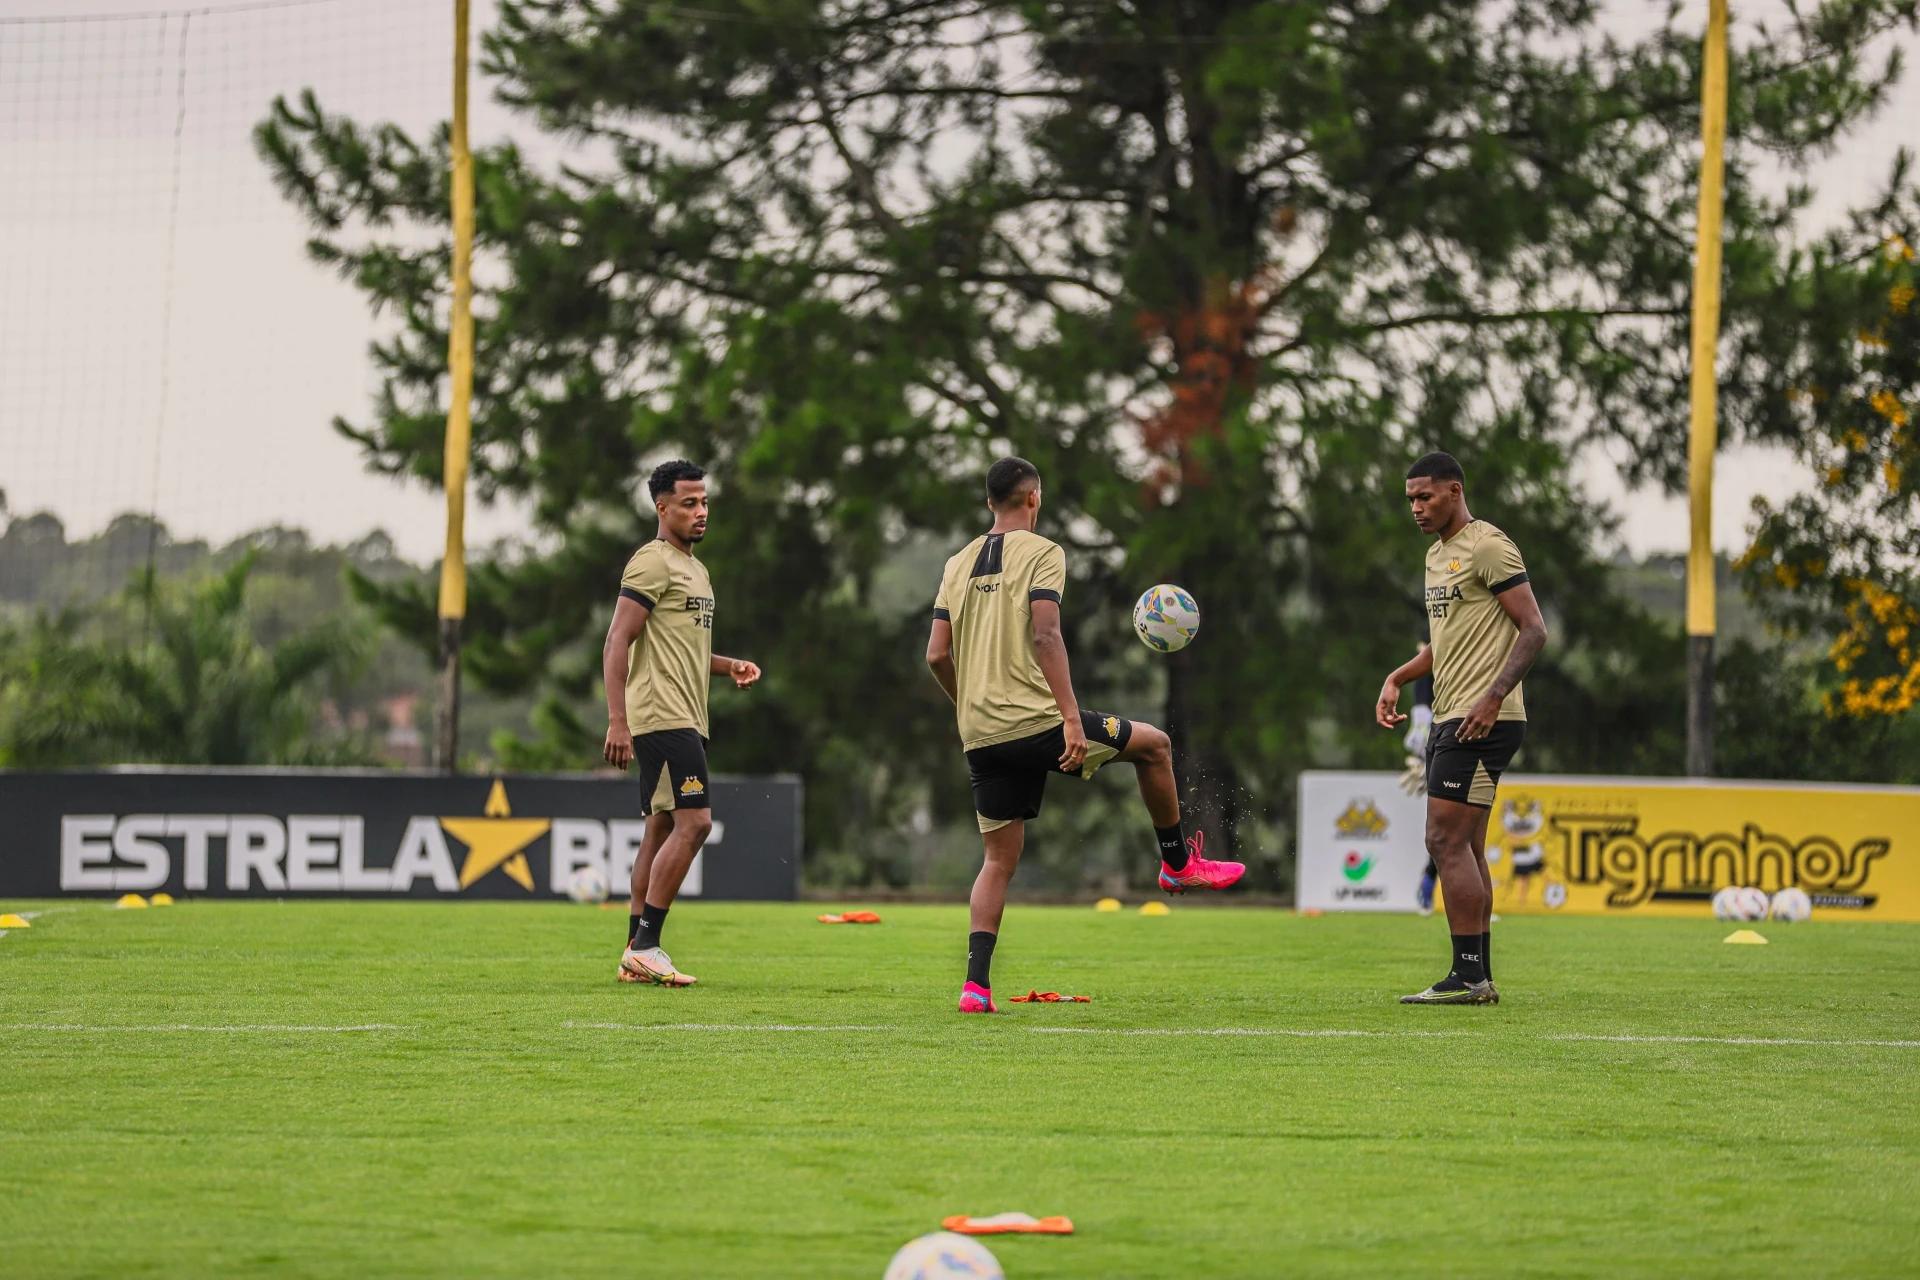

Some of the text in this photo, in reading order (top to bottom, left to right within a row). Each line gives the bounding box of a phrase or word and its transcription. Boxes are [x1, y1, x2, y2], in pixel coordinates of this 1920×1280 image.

[1432, 603, 1449, 618] BET
[60, 814, 460, 892] ESTRELA
[1461, 953, 1479, 961] CEC
